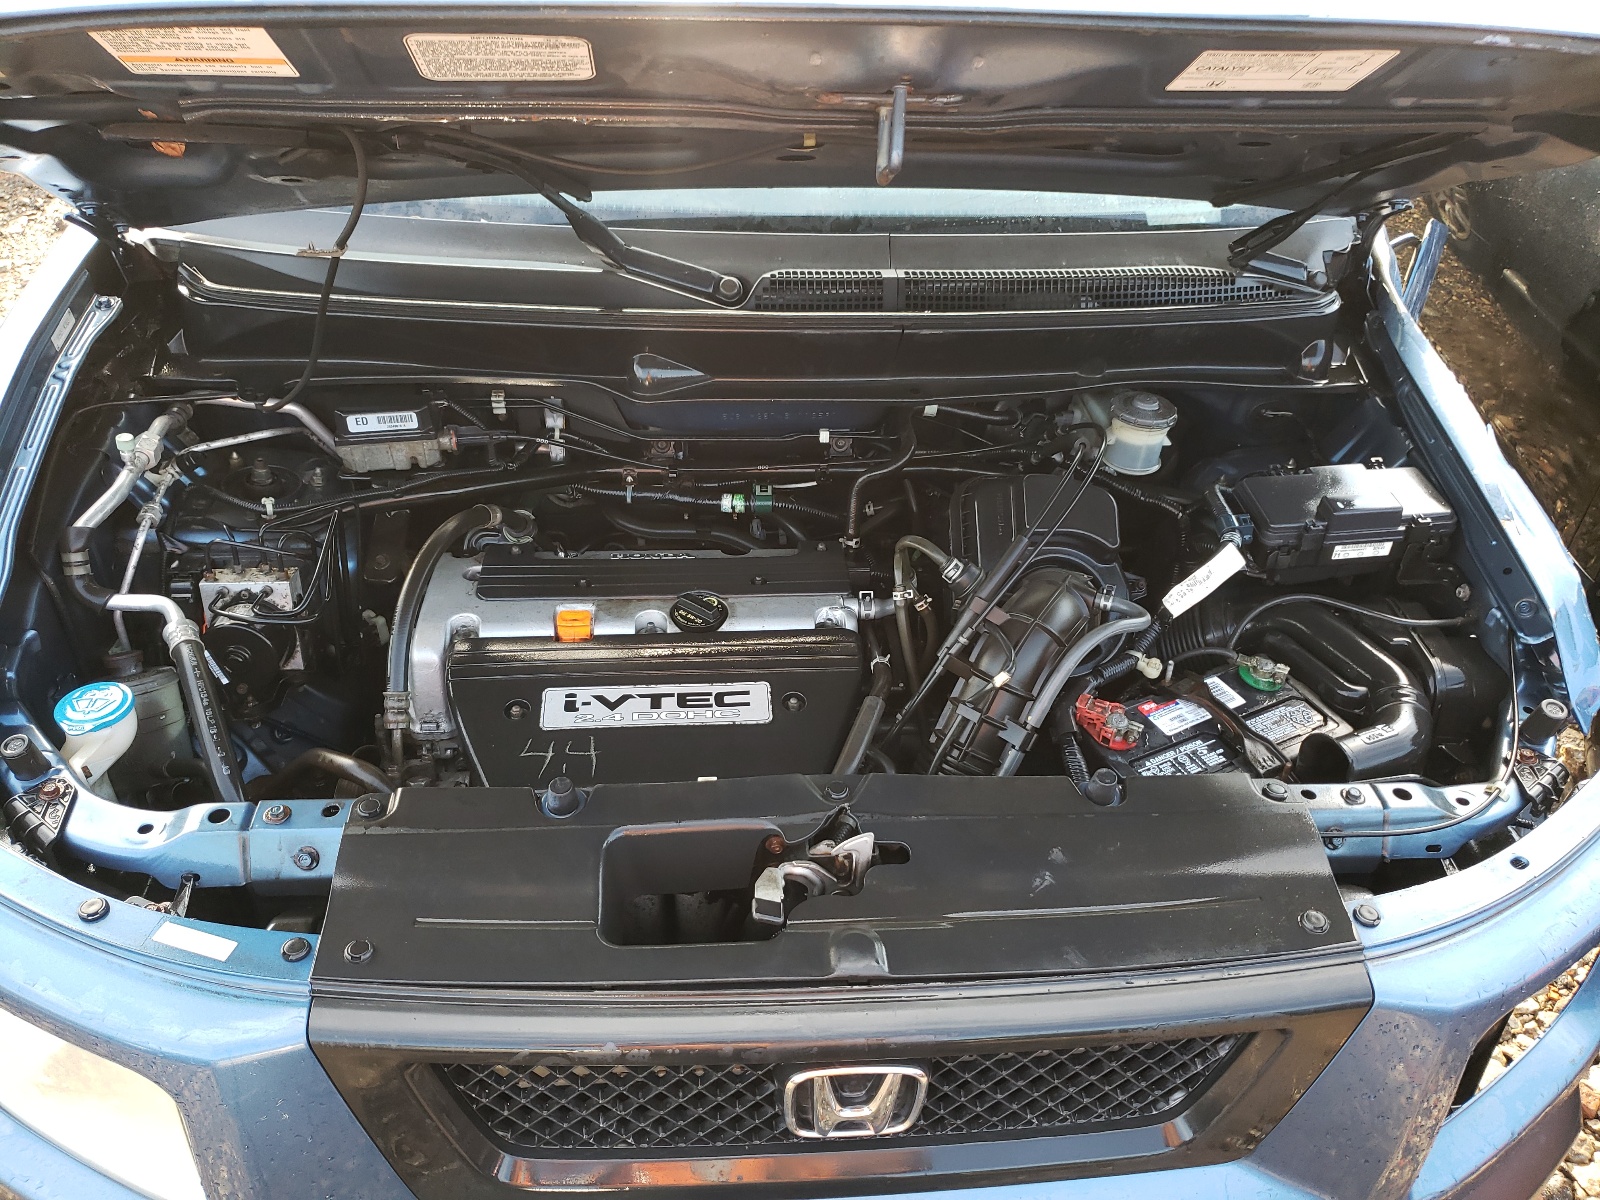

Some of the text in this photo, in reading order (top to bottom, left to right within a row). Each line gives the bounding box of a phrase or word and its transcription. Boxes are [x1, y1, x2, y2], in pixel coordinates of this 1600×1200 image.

[354, 416, 369, 426] ED
[610, 552, 696, 560] HONDA
[563, 689, 751, 713] i-VTEC
[573, 708, 742, 724] 2.4 DOHC
